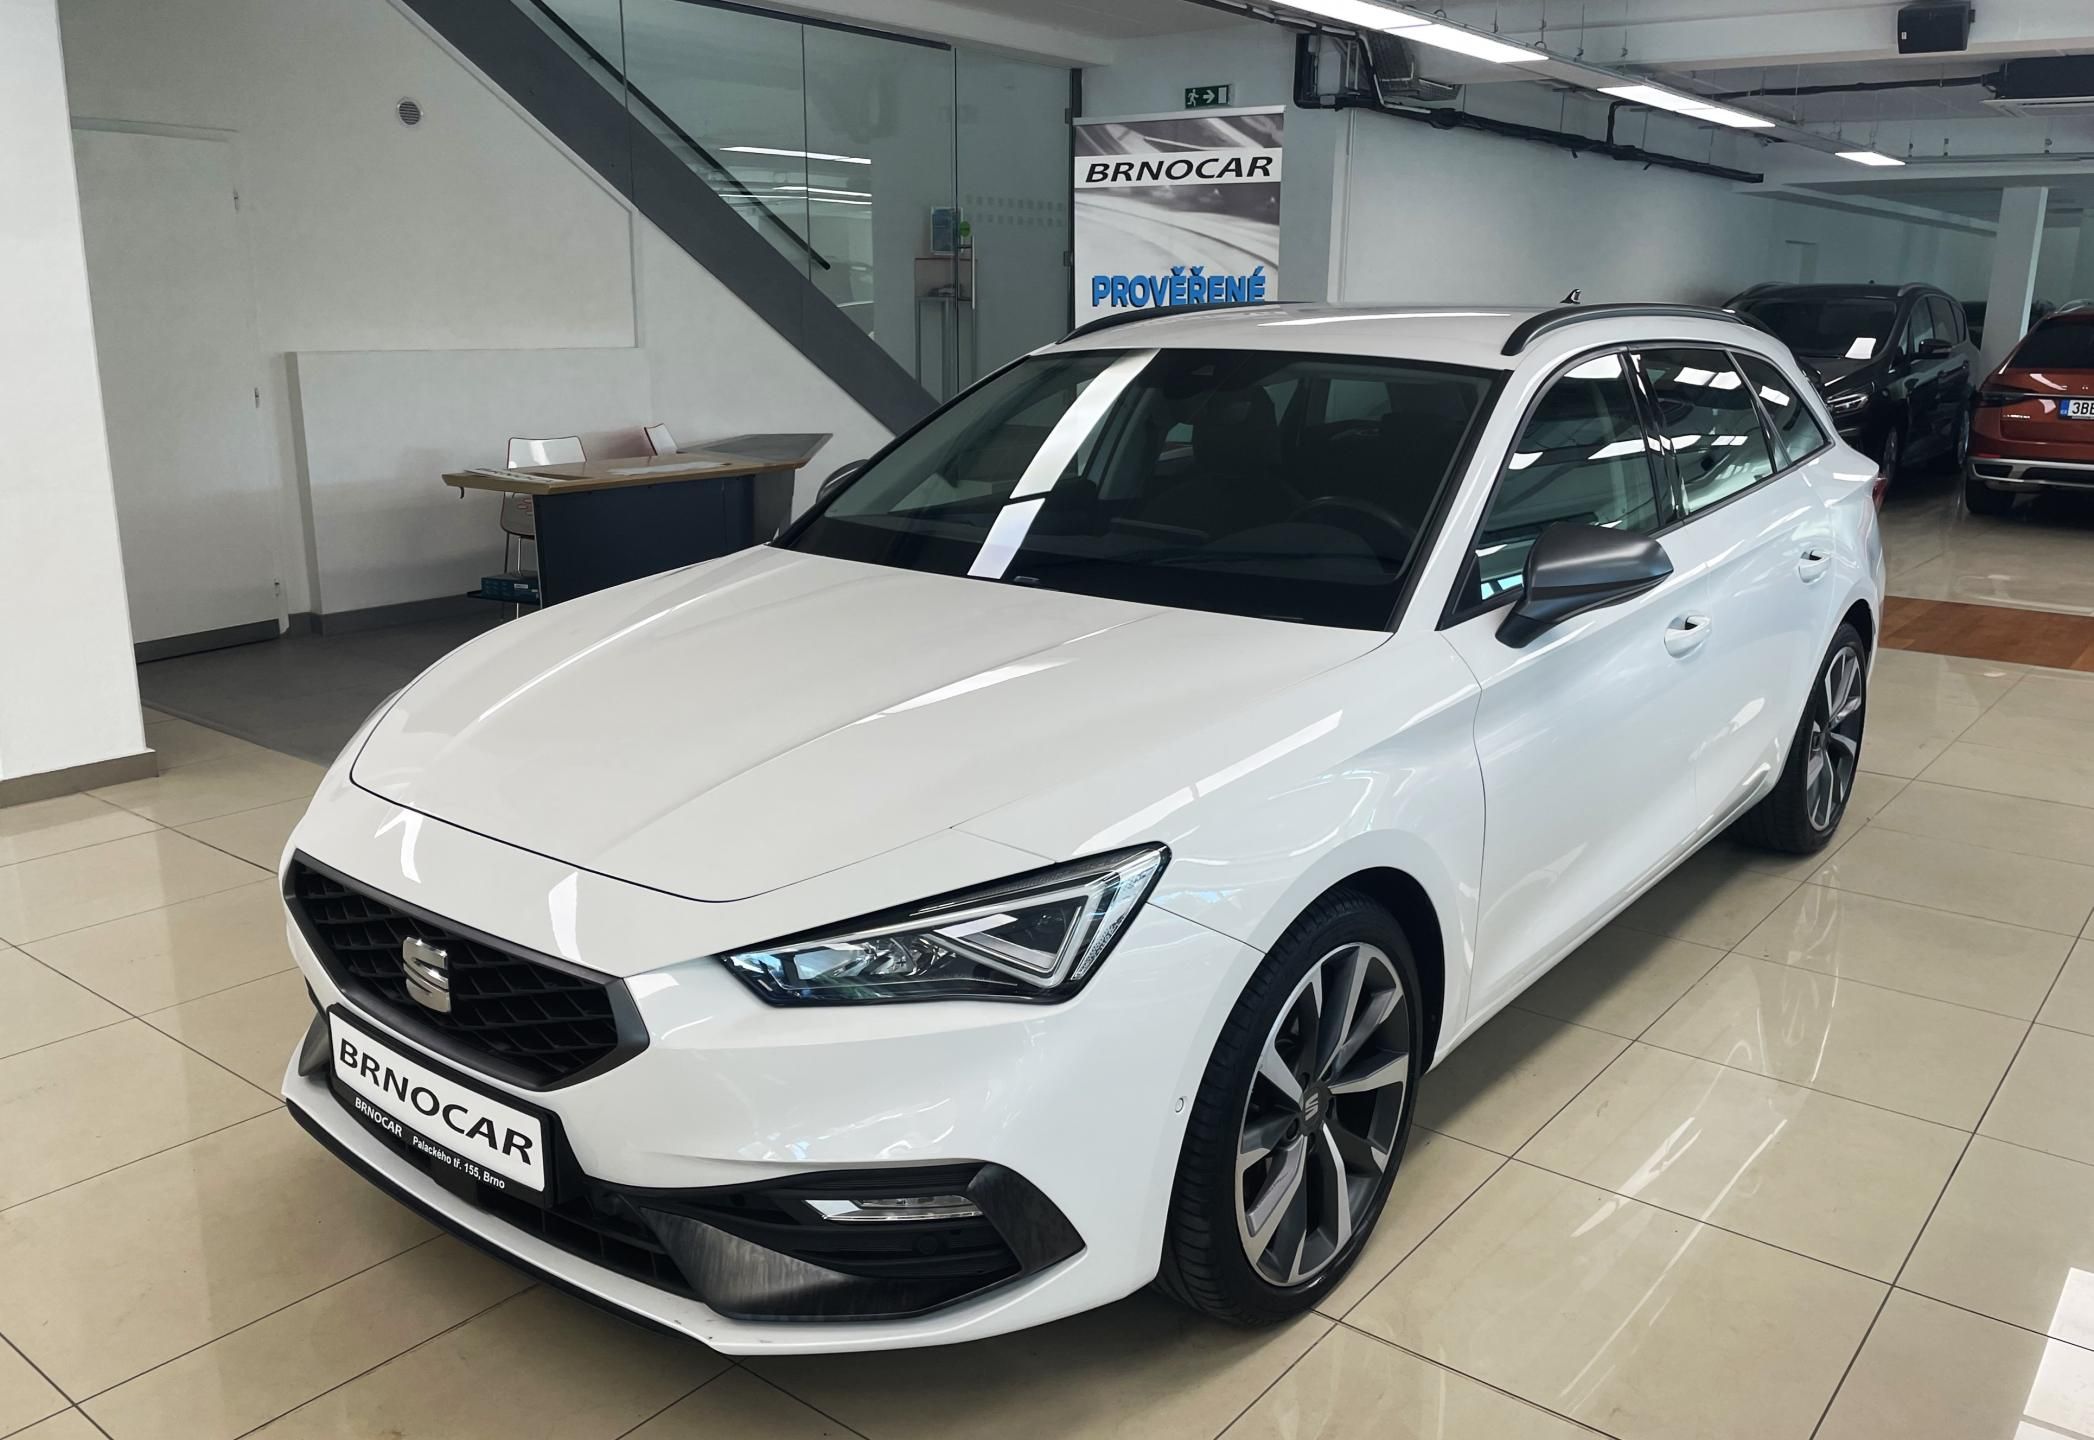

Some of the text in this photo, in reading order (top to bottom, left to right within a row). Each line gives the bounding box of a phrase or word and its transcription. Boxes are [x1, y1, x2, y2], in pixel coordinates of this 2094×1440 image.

[1085, 156, 1273, 183] BRNOCAR
[1092, 265, 1266, 308] PROVĚŘENÉ
[339, 1038, 533, 1165] BRNOCAR
[355, 1097, 505, 1189] BRNOCAR Palackého tř. 155, Brno
